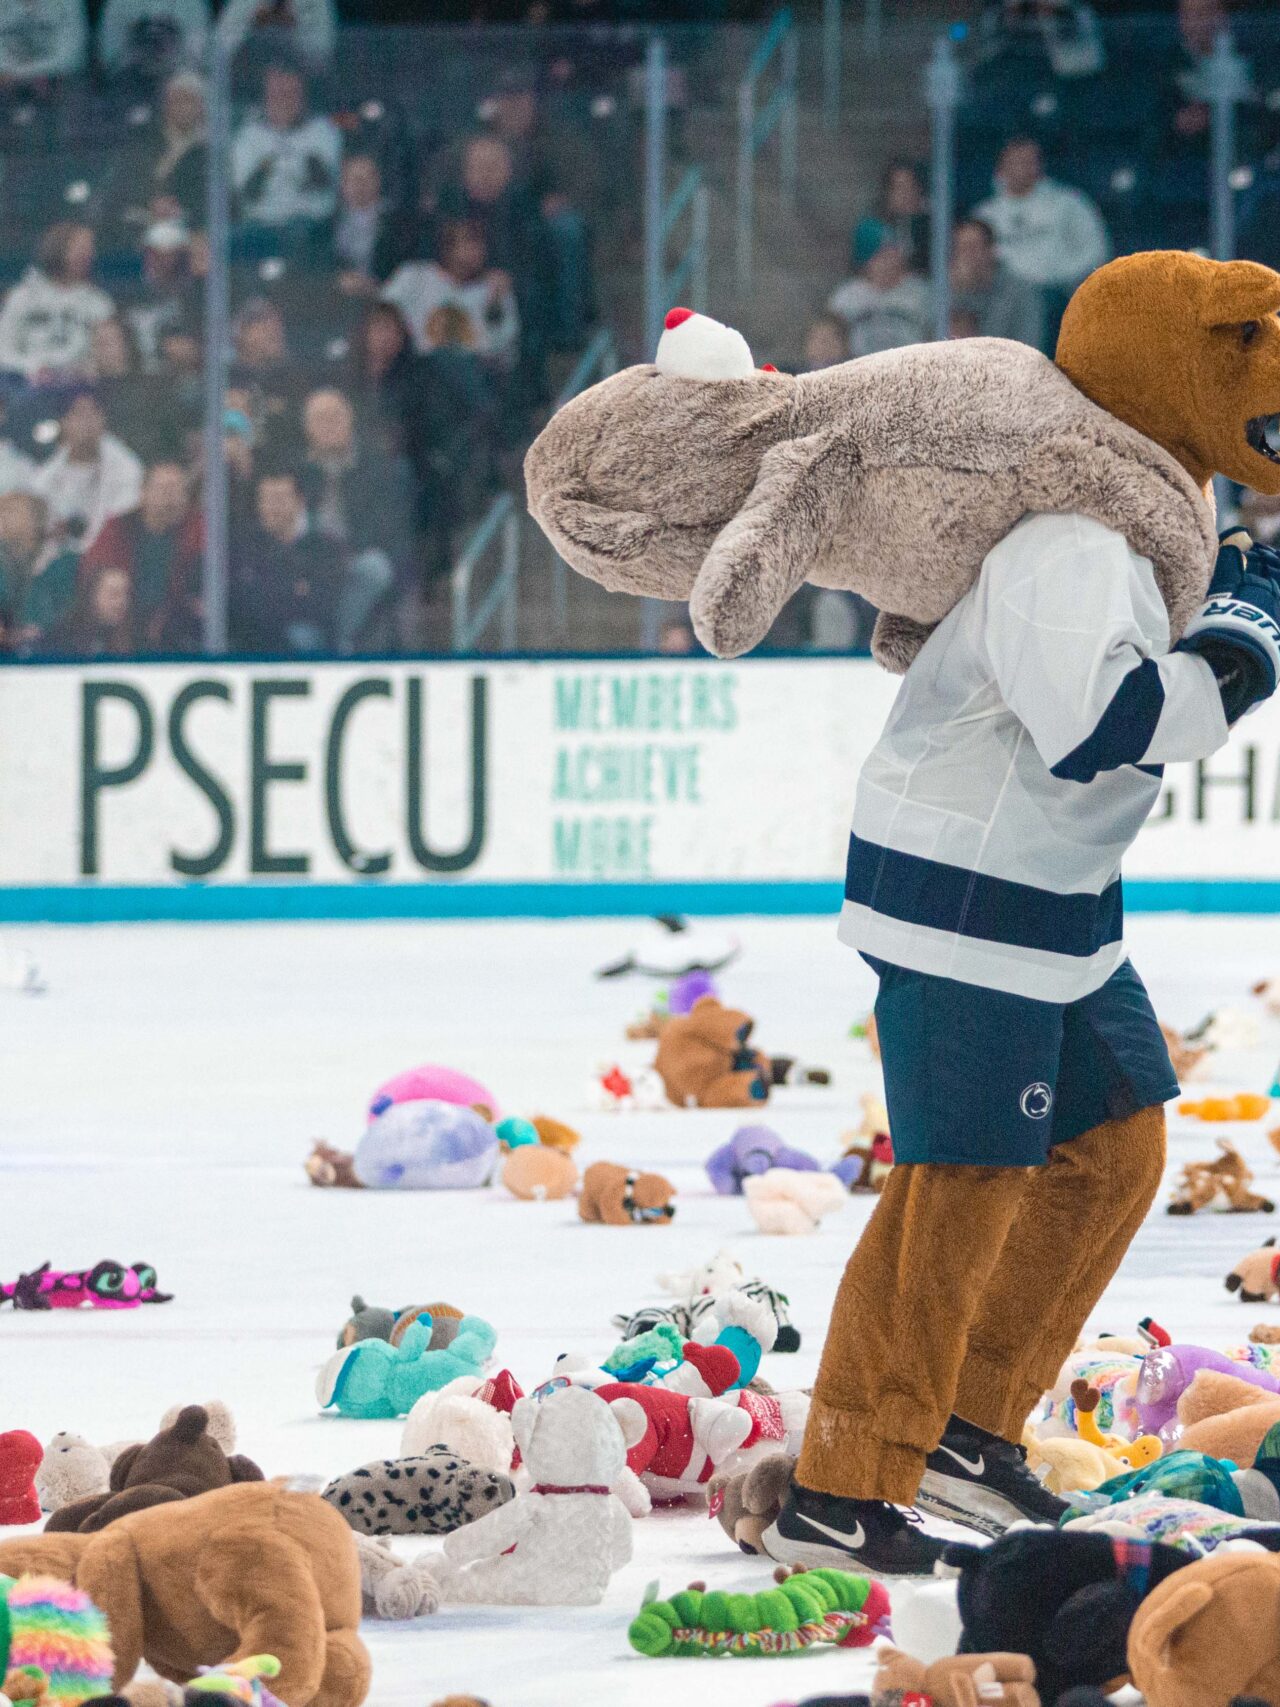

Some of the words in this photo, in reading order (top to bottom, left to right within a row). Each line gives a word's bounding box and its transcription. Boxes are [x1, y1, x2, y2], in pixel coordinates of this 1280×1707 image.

[554, 674, 738, 732] MEMBERS
[82, 677, 487, 876] PSECU
[553, 745, 702, 801] ACHIEVE
[554, 817, 655, 872] MORE
